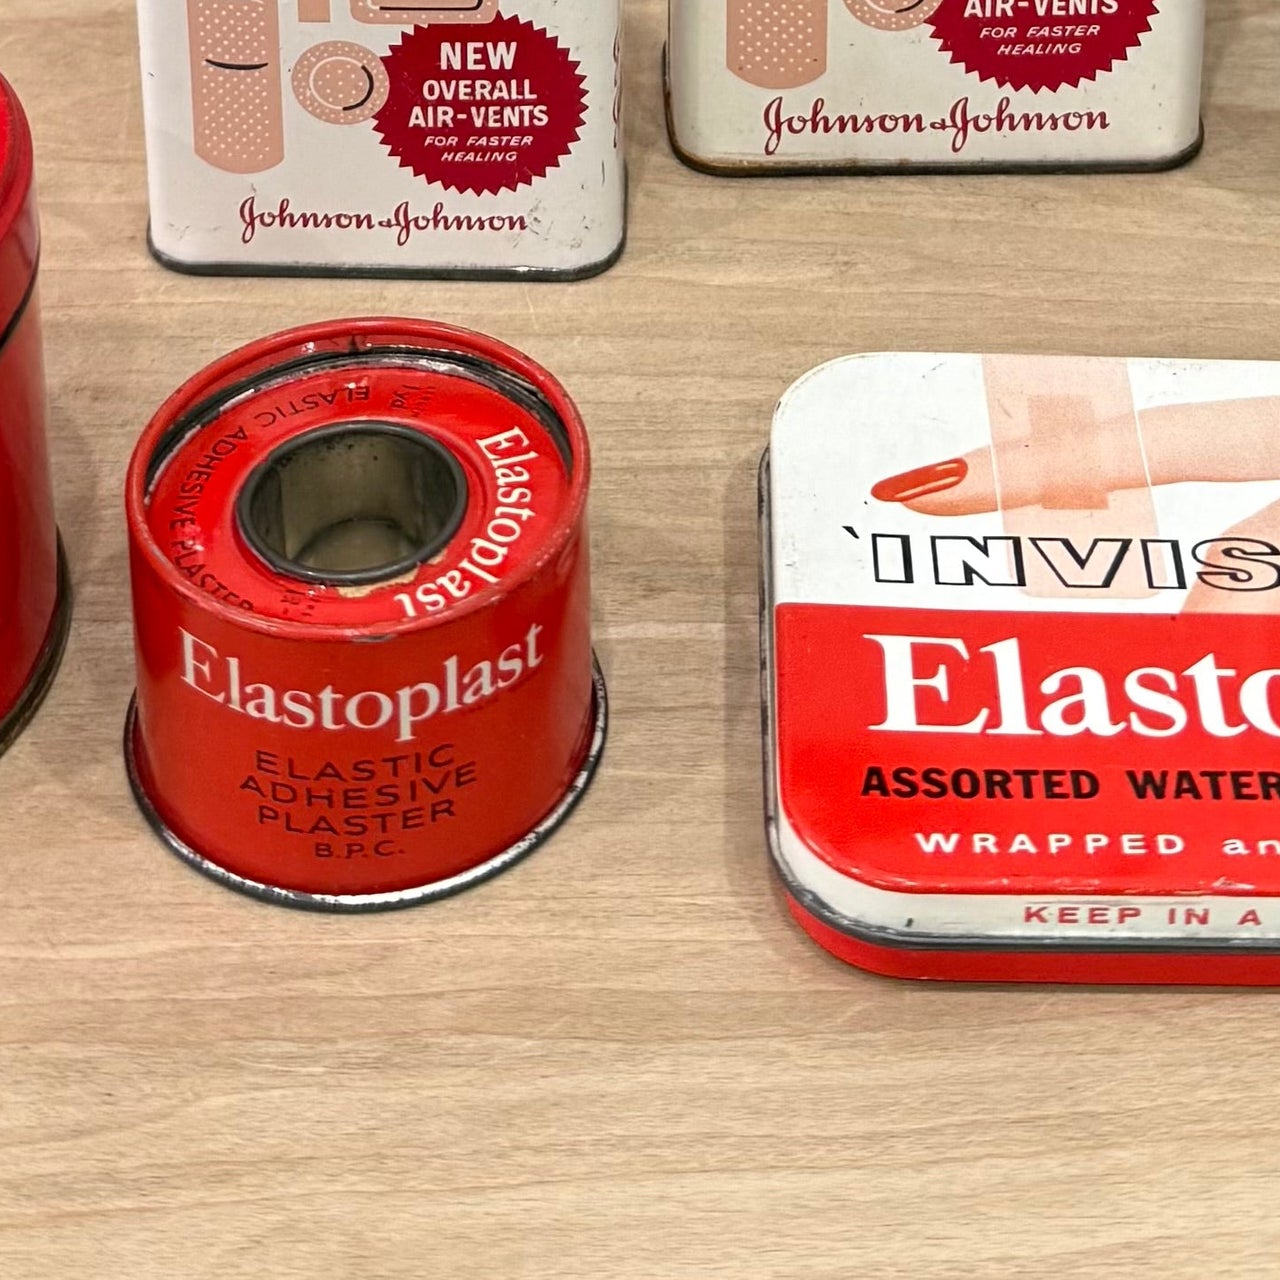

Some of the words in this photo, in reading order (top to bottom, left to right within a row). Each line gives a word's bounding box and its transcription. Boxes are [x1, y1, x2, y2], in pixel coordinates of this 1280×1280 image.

[979, 25, 1020, 39] FOR
[1026, 24, 1101, 38] FASTER
[439, 41, 518, 71] NEW
[996, 41, 1083, 57] HEALING
[422, 79, 538, 102] OVERALL
[408, 104, 550, 129] AIR-VENTS
[763, 95, 927, 156] Johnson
[947, 95, 1111, 153] Johnson
[424, 134, 460, 148] FOR
[467, 134, 534, 148] FASTER
[440, 151, 519, 163] HEALING
[239, 195, 376, 244] Johnson
[392, 201, 529, 246] Johnson
[253, 385, 371, 429] ELASTIC
[169, 424, 249, 531] ADHESIVE
[178, 621, 544, 743] Elastoplast
[255, 742, 457, 784] ELASTIC
[238, 758, 478, 811] ADHESIVE
[860, 766, 1101, 801] ASSORTED
[258, 799, 457, 836] PLASTER
[313, 840, 405, 859] B.P.C.
[913, 832, 1186, 855] WRAPPED
[1023, 905, 1143, 925] KEEP
[1168, 907, 1210, 926] IN
[1236, 908, 1263, 926] A
